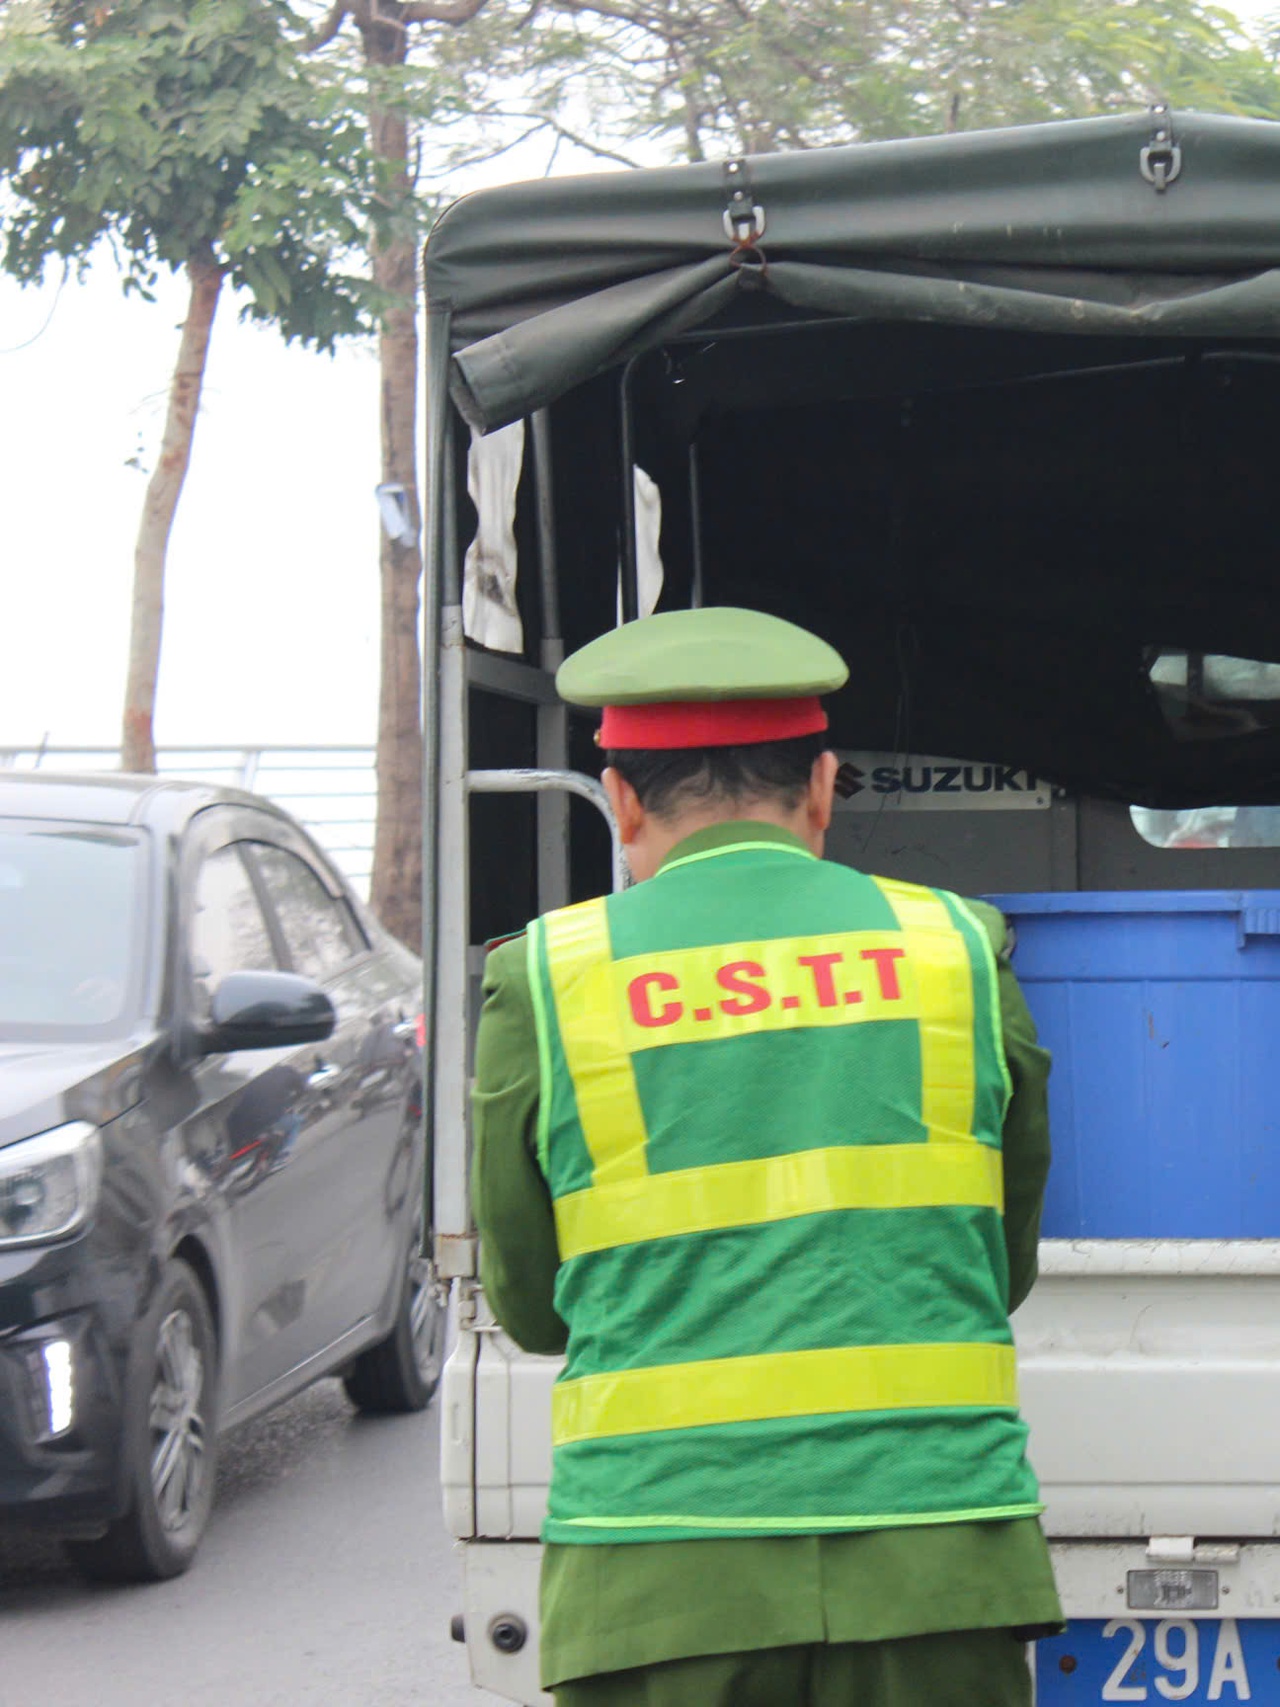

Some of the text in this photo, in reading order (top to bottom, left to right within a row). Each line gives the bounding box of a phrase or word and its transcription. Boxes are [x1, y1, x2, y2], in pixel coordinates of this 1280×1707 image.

[872, 766, 1037, 793] SUZUKI
[628, 948, 905, 1027] C.S.T.T
[1102, 1619, 1251, 1701] 29A
